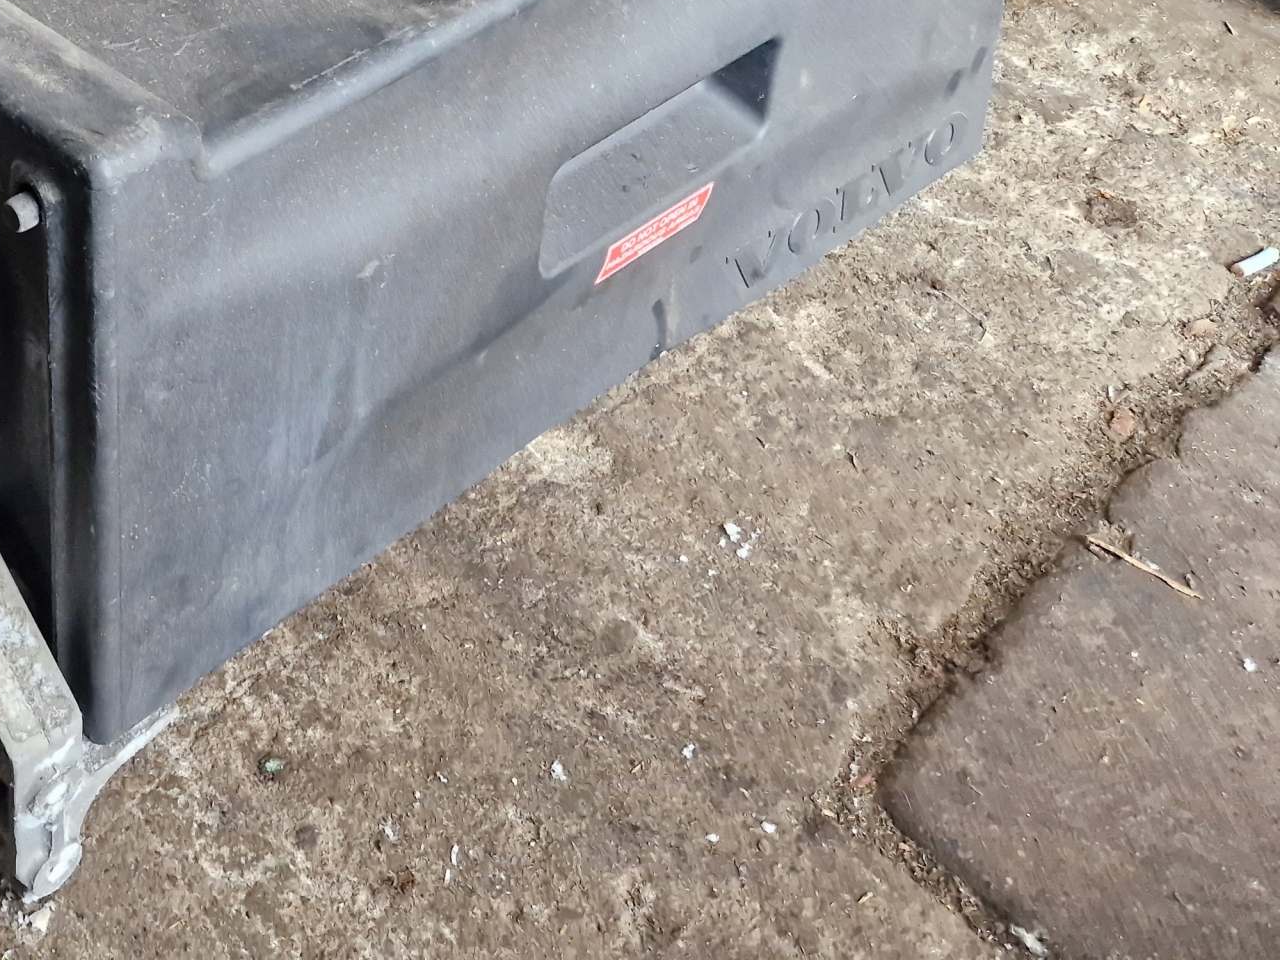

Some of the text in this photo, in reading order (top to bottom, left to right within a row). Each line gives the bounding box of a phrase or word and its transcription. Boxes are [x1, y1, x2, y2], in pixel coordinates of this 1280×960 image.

[620, 237, 637, 253] DO
[637, 222, 660, 242] NOT
[659, 204, 687, 227] OPEN
[686, 197, 699, 211] IN
[725, 111, 968, 288] VOLVO
